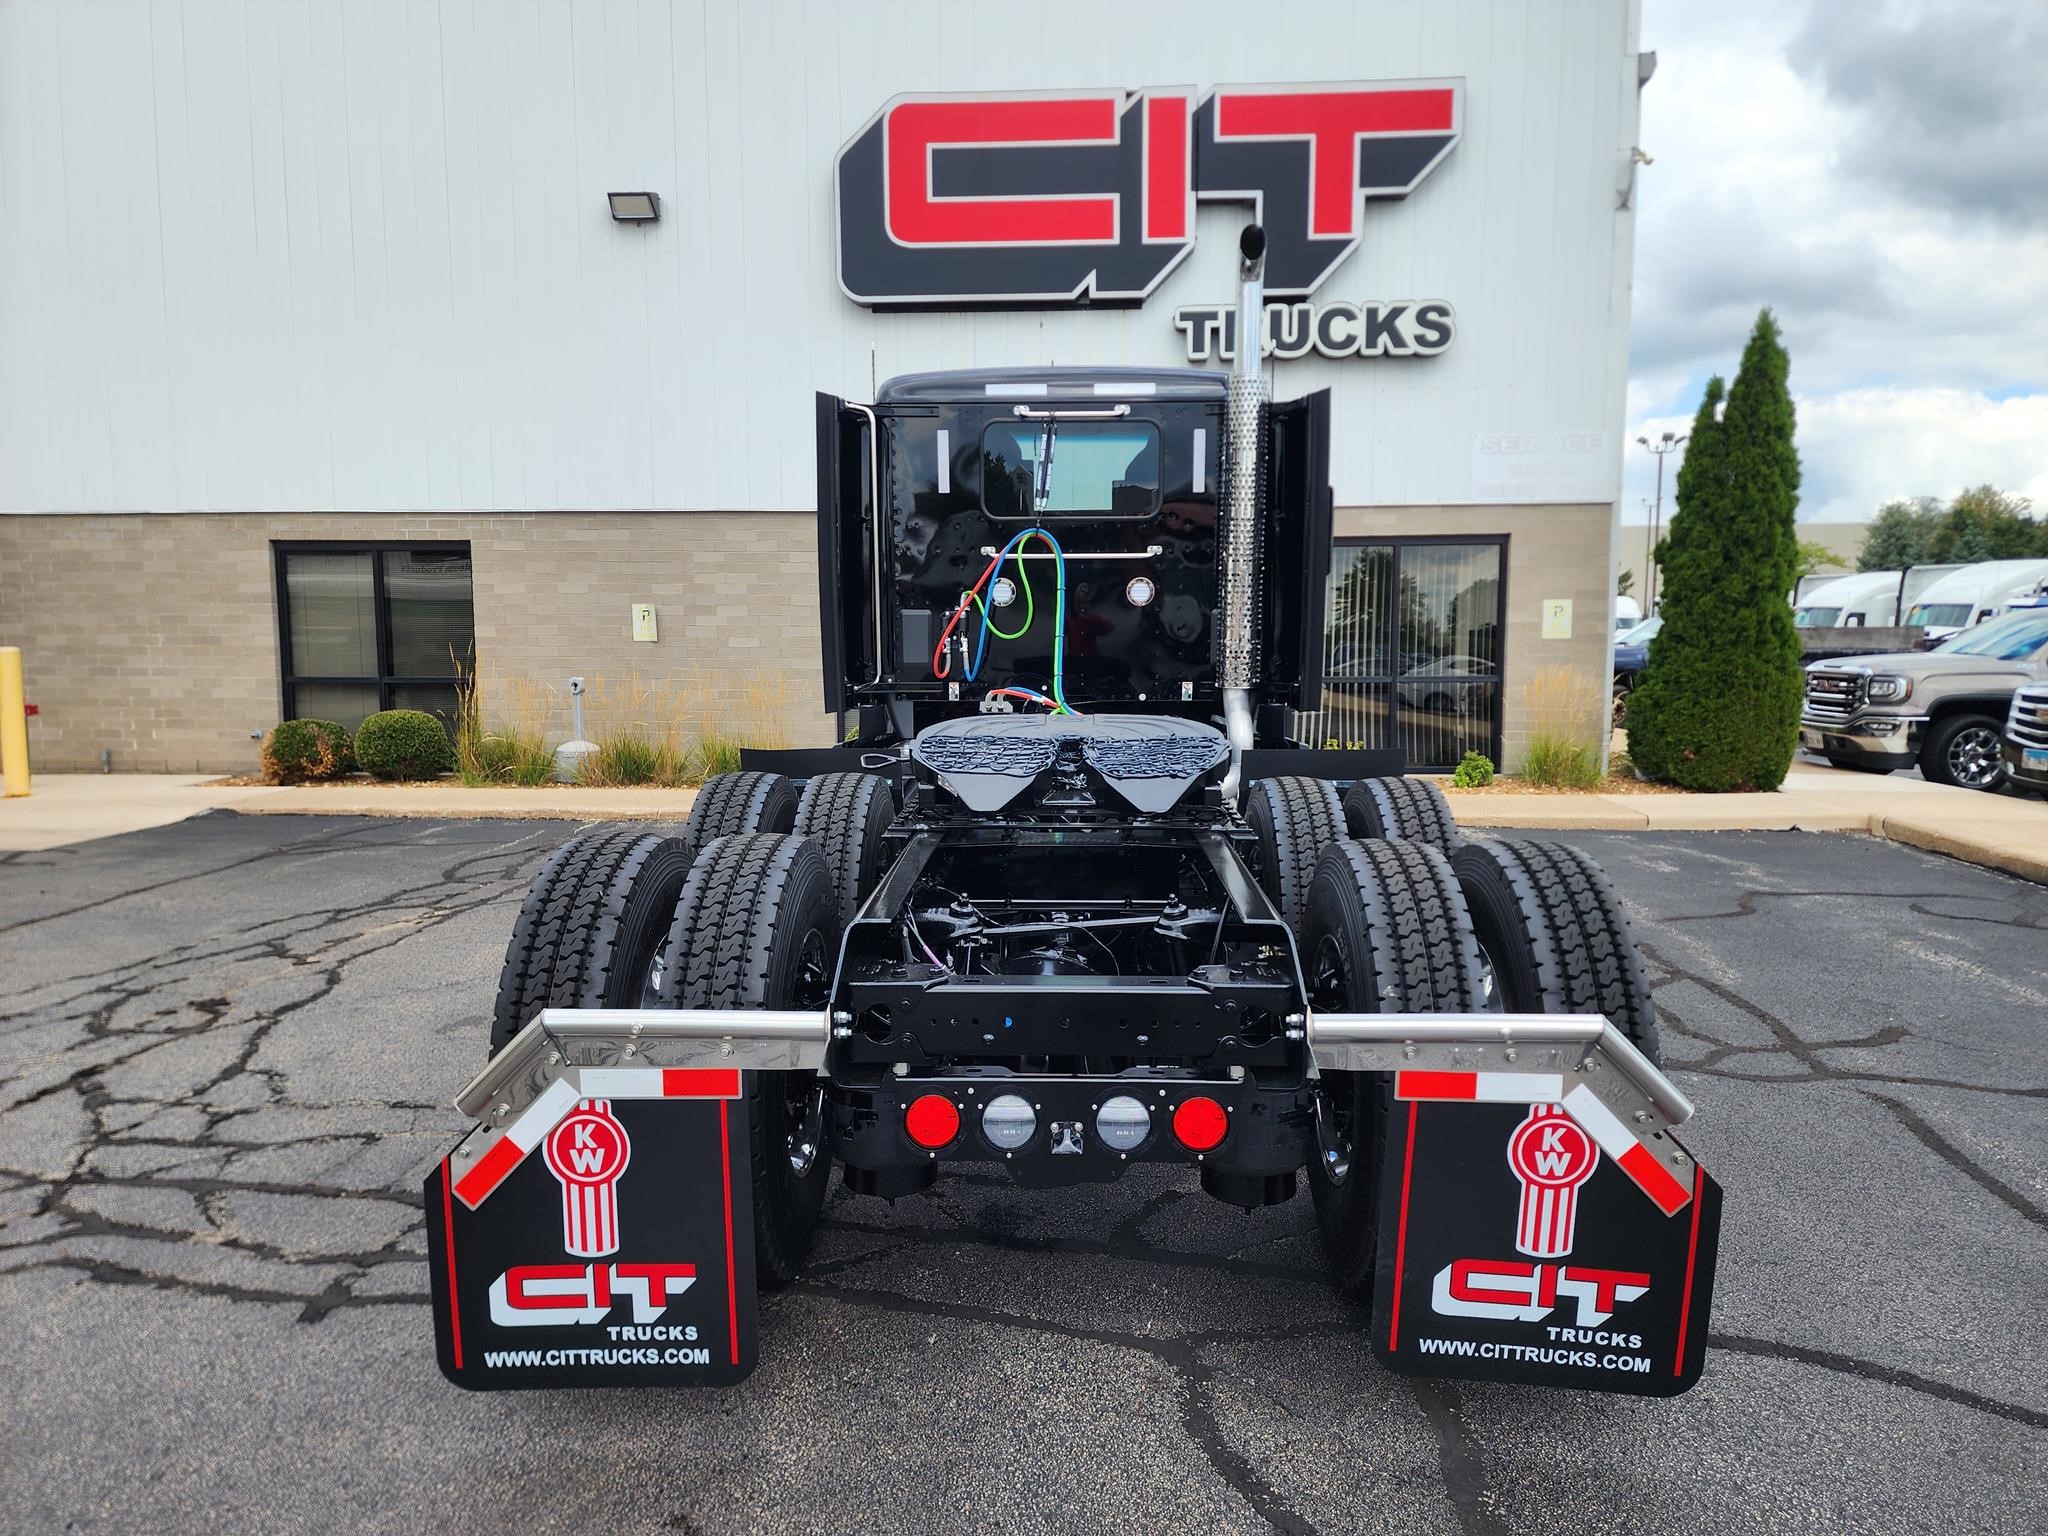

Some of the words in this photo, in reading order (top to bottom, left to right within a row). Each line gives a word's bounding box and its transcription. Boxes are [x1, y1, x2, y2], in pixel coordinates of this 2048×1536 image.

[835, 77, 1464, 306] CIT
[489, 1263, 697, 1328] CIT
[1432, 1258, 1652, 1328] CIT
[606, 1325, 698, 1342] TRUCKS
[1546, 1326, 1643, 1349] TRUCKS
[483, 1347, 710, 1368] WWW.CITTRUCKS.COM
[1418, 1338, 1652, 1374] WWW.CITTRUCKS.COM
